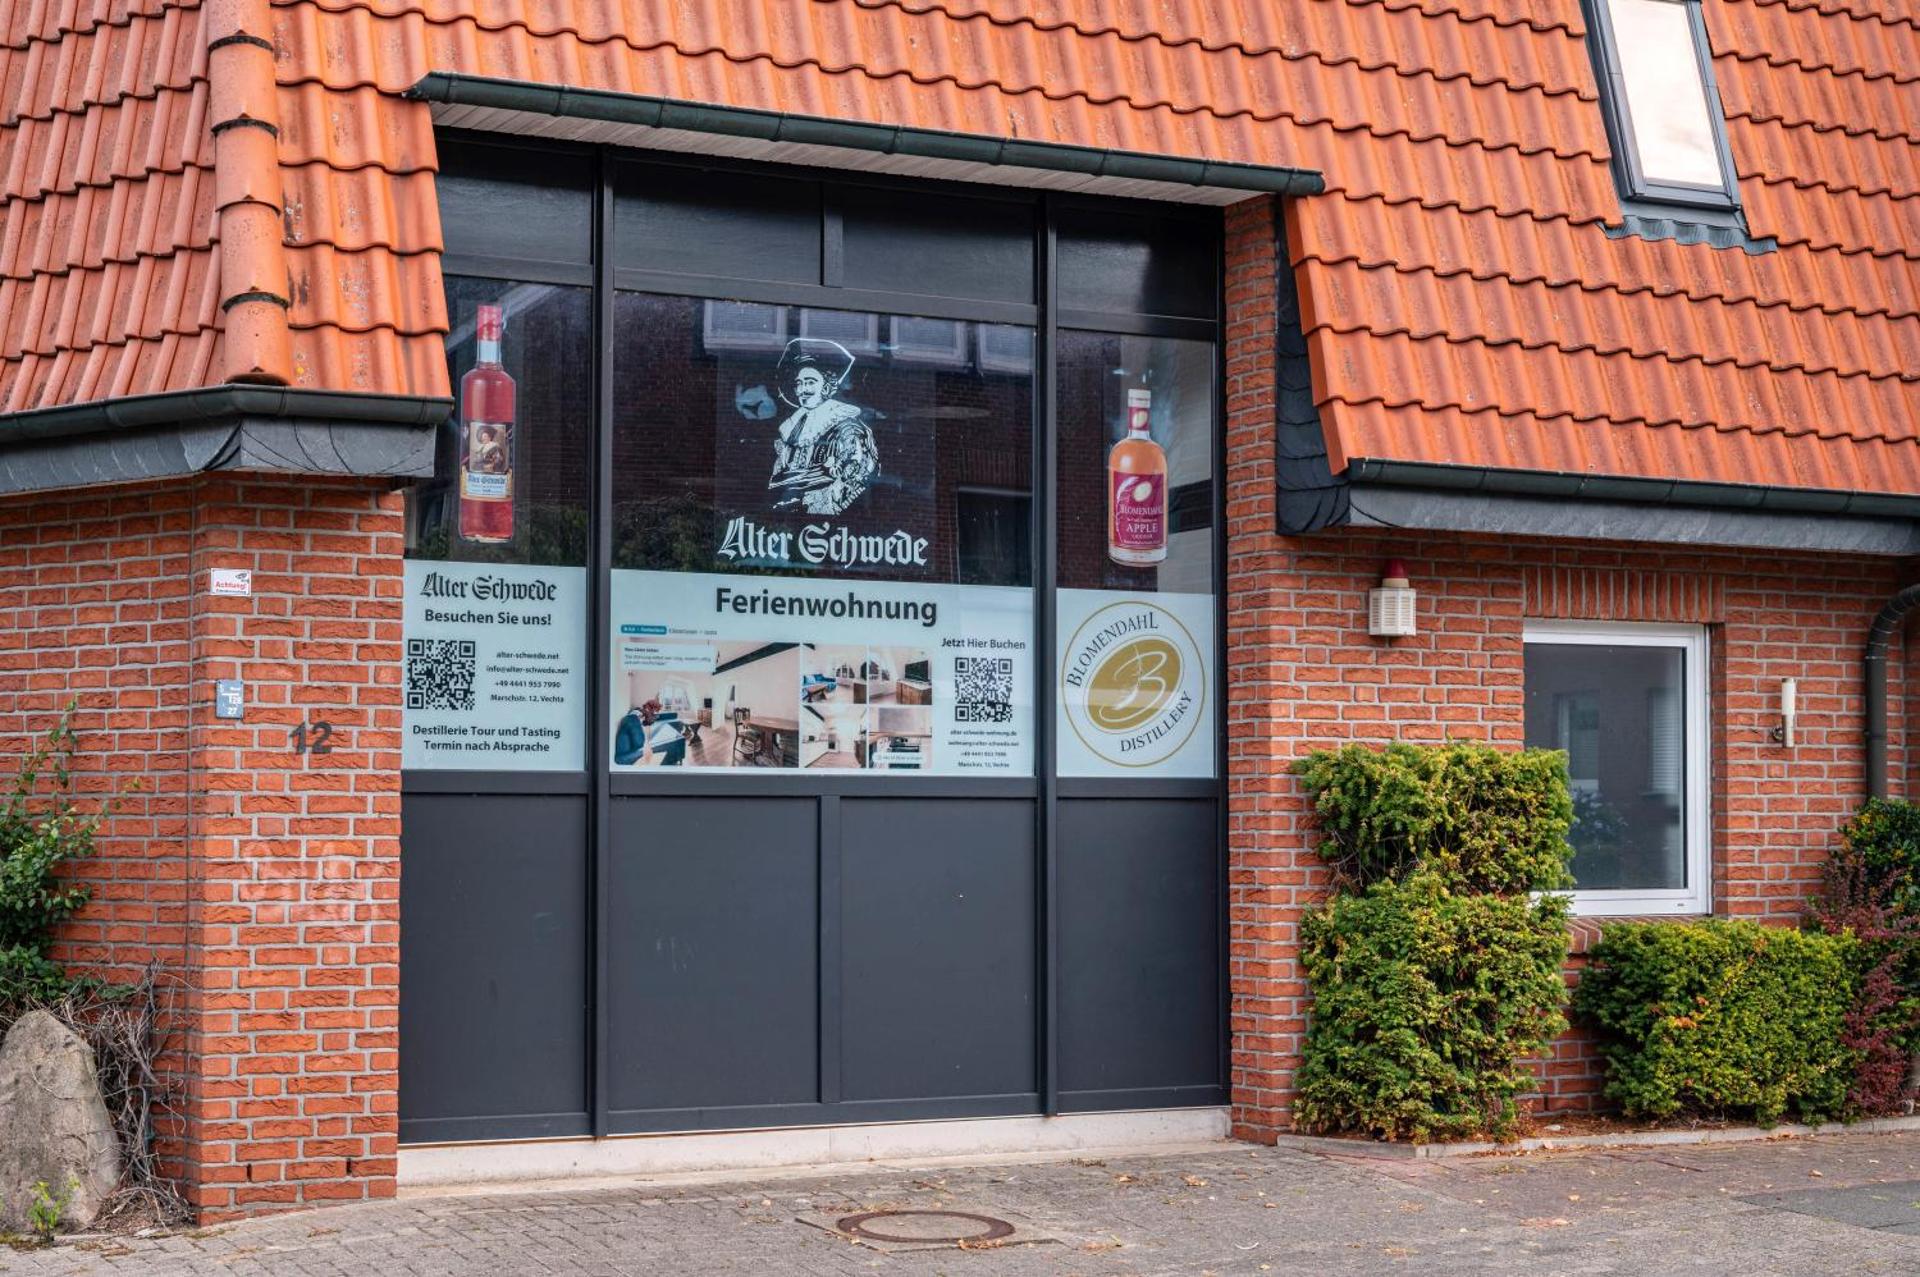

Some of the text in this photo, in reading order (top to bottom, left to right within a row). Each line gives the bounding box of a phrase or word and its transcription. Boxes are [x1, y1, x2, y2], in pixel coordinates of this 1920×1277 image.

[1126, 523, 1158, 533] APPLE
[717, 516, 929, 569] Alter Schwede
[420, 572, 557, 603] Alter Schwede
[716, 587, 937, 627] Ferienwohnung
[425, 609, 551, 626] Besuchen Sie uns!
[942, 638, 1026, 650] Jetzt Hier Buchen
[1066, 612, 1159, 688] BLOMENDAHL
[496, 651, 559, 660] alter-schwede.net
[486, 665, 569, 674] info@alter-schwede.net
[540, 695, 564, 703] Vechta
[1121, 690, 1192, 752] DISTILLERY
[289, 721, 332, 754] 12
[413, 725, 561, 739] Destillerie Tour und Tasting
[424, 741, 550, 753] Termin nach Absprache
